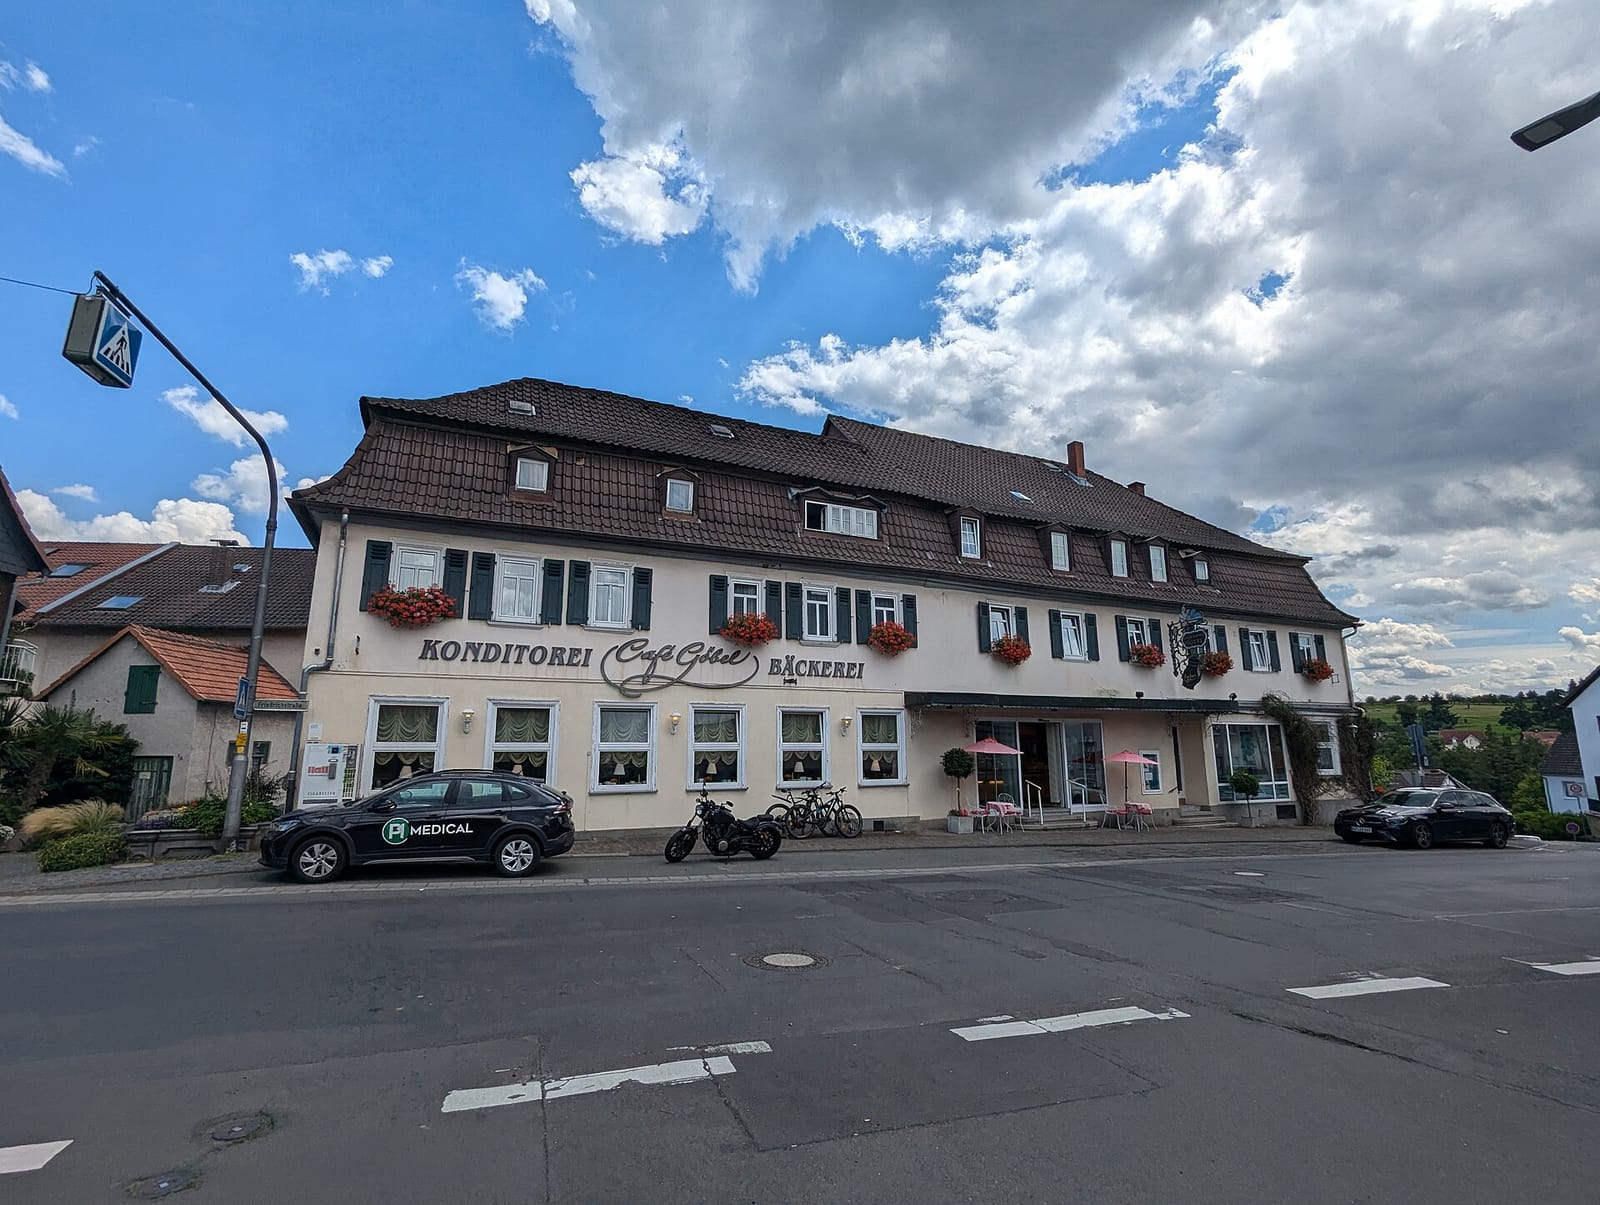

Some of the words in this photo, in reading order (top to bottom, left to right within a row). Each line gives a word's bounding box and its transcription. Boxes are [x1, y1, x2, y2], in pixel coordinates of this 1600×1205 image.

[418, 639, 593, 667] KONDITOREI
[616, 638, 677, 684] Café
[676, 641, 751, 666] Göbel
[768, 655, 865, 679] BÄCKEREI
[410, 822, 474, 836] MEDICAL
